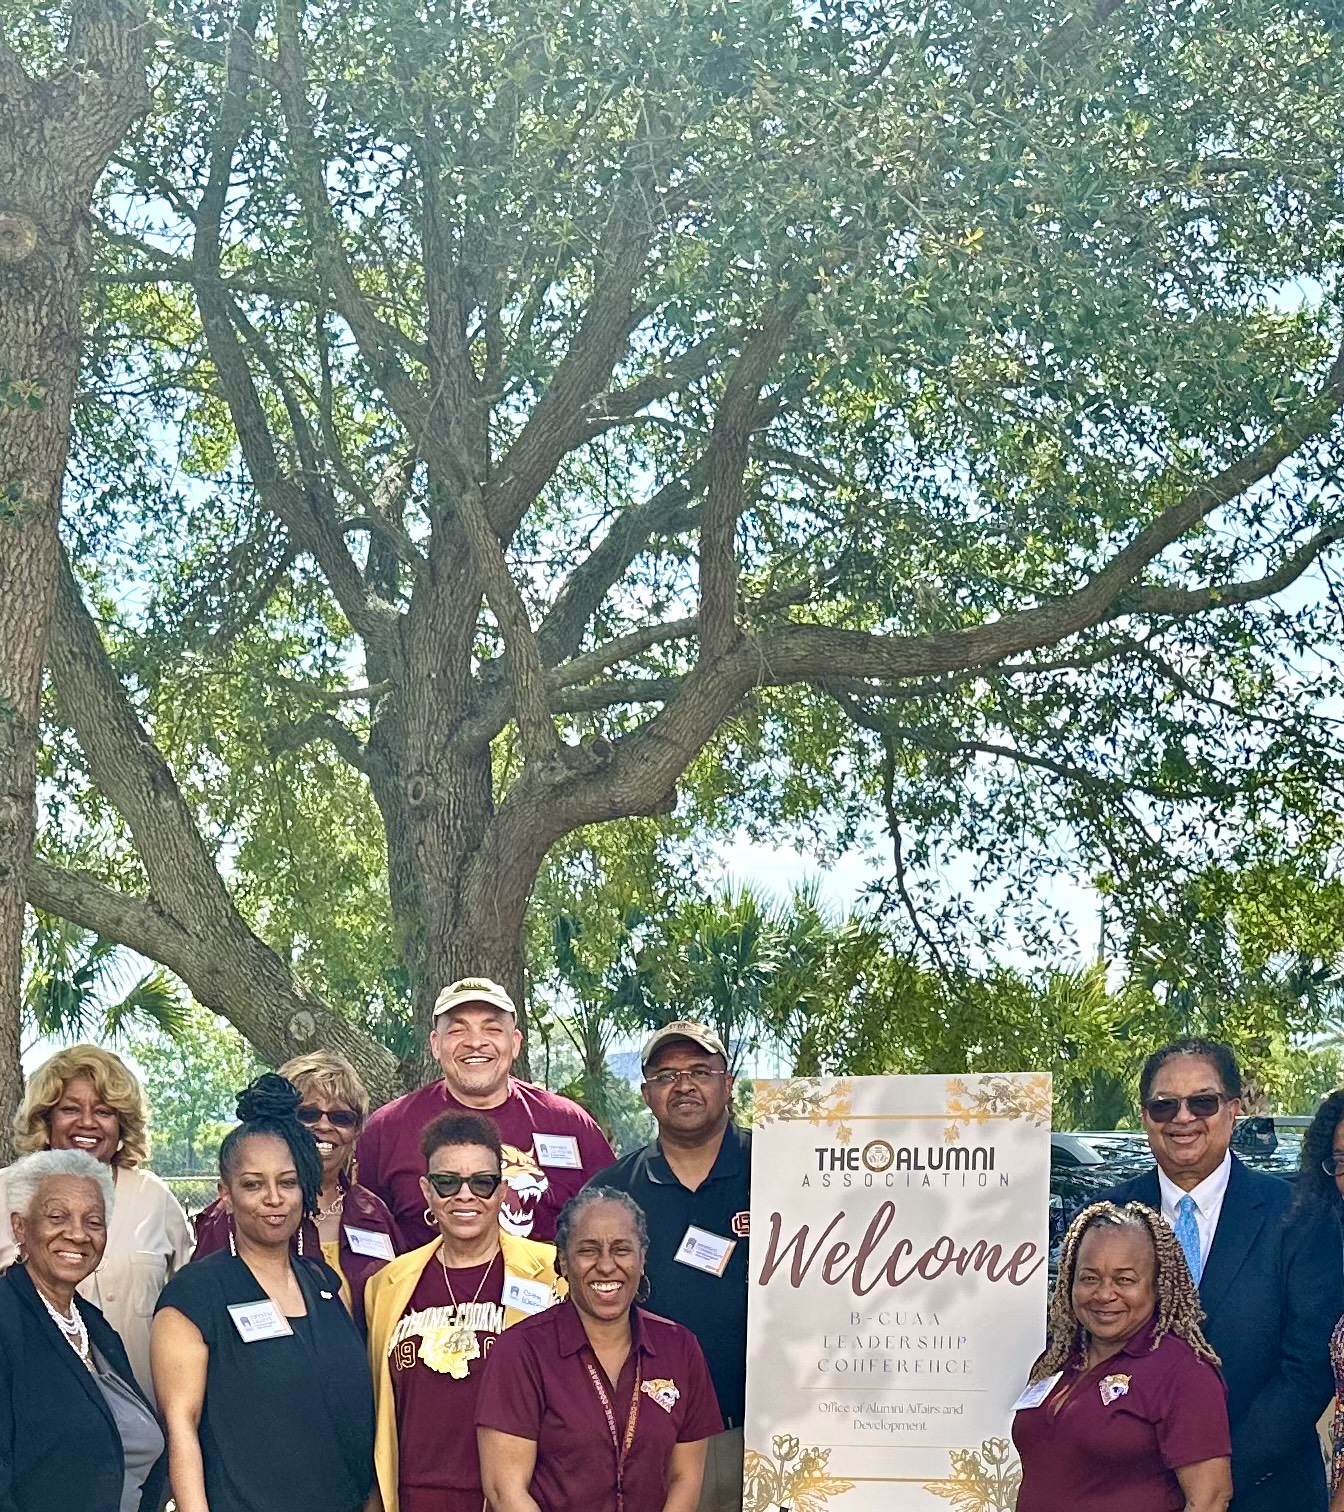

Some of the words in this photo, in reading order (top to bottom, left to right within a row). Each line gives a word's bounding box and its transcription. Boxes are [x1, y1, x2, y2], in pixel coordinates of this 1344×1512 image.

[815, 1147, 860, 1171] THE
[896, 1146, 995, 1171] ALUMNI
[801, 1172, 1010, 1188] ASSOCIATION
[758, 1200, 1045, 1297] Welcome
[822, 1334, 968, 1351] LEADERSHIP
[817, 1358, 973, 1374] CONFERENCE
[818, 1402, 850, 1414] Office
[852, 1402, 864, 1414] of
[865, 1402, 905, 1415] Alumni
[906, 1402, 941, 1415] Affairs
[942, 1403, 964, 1415] and
[852, 1419, 928, 1433] Development
